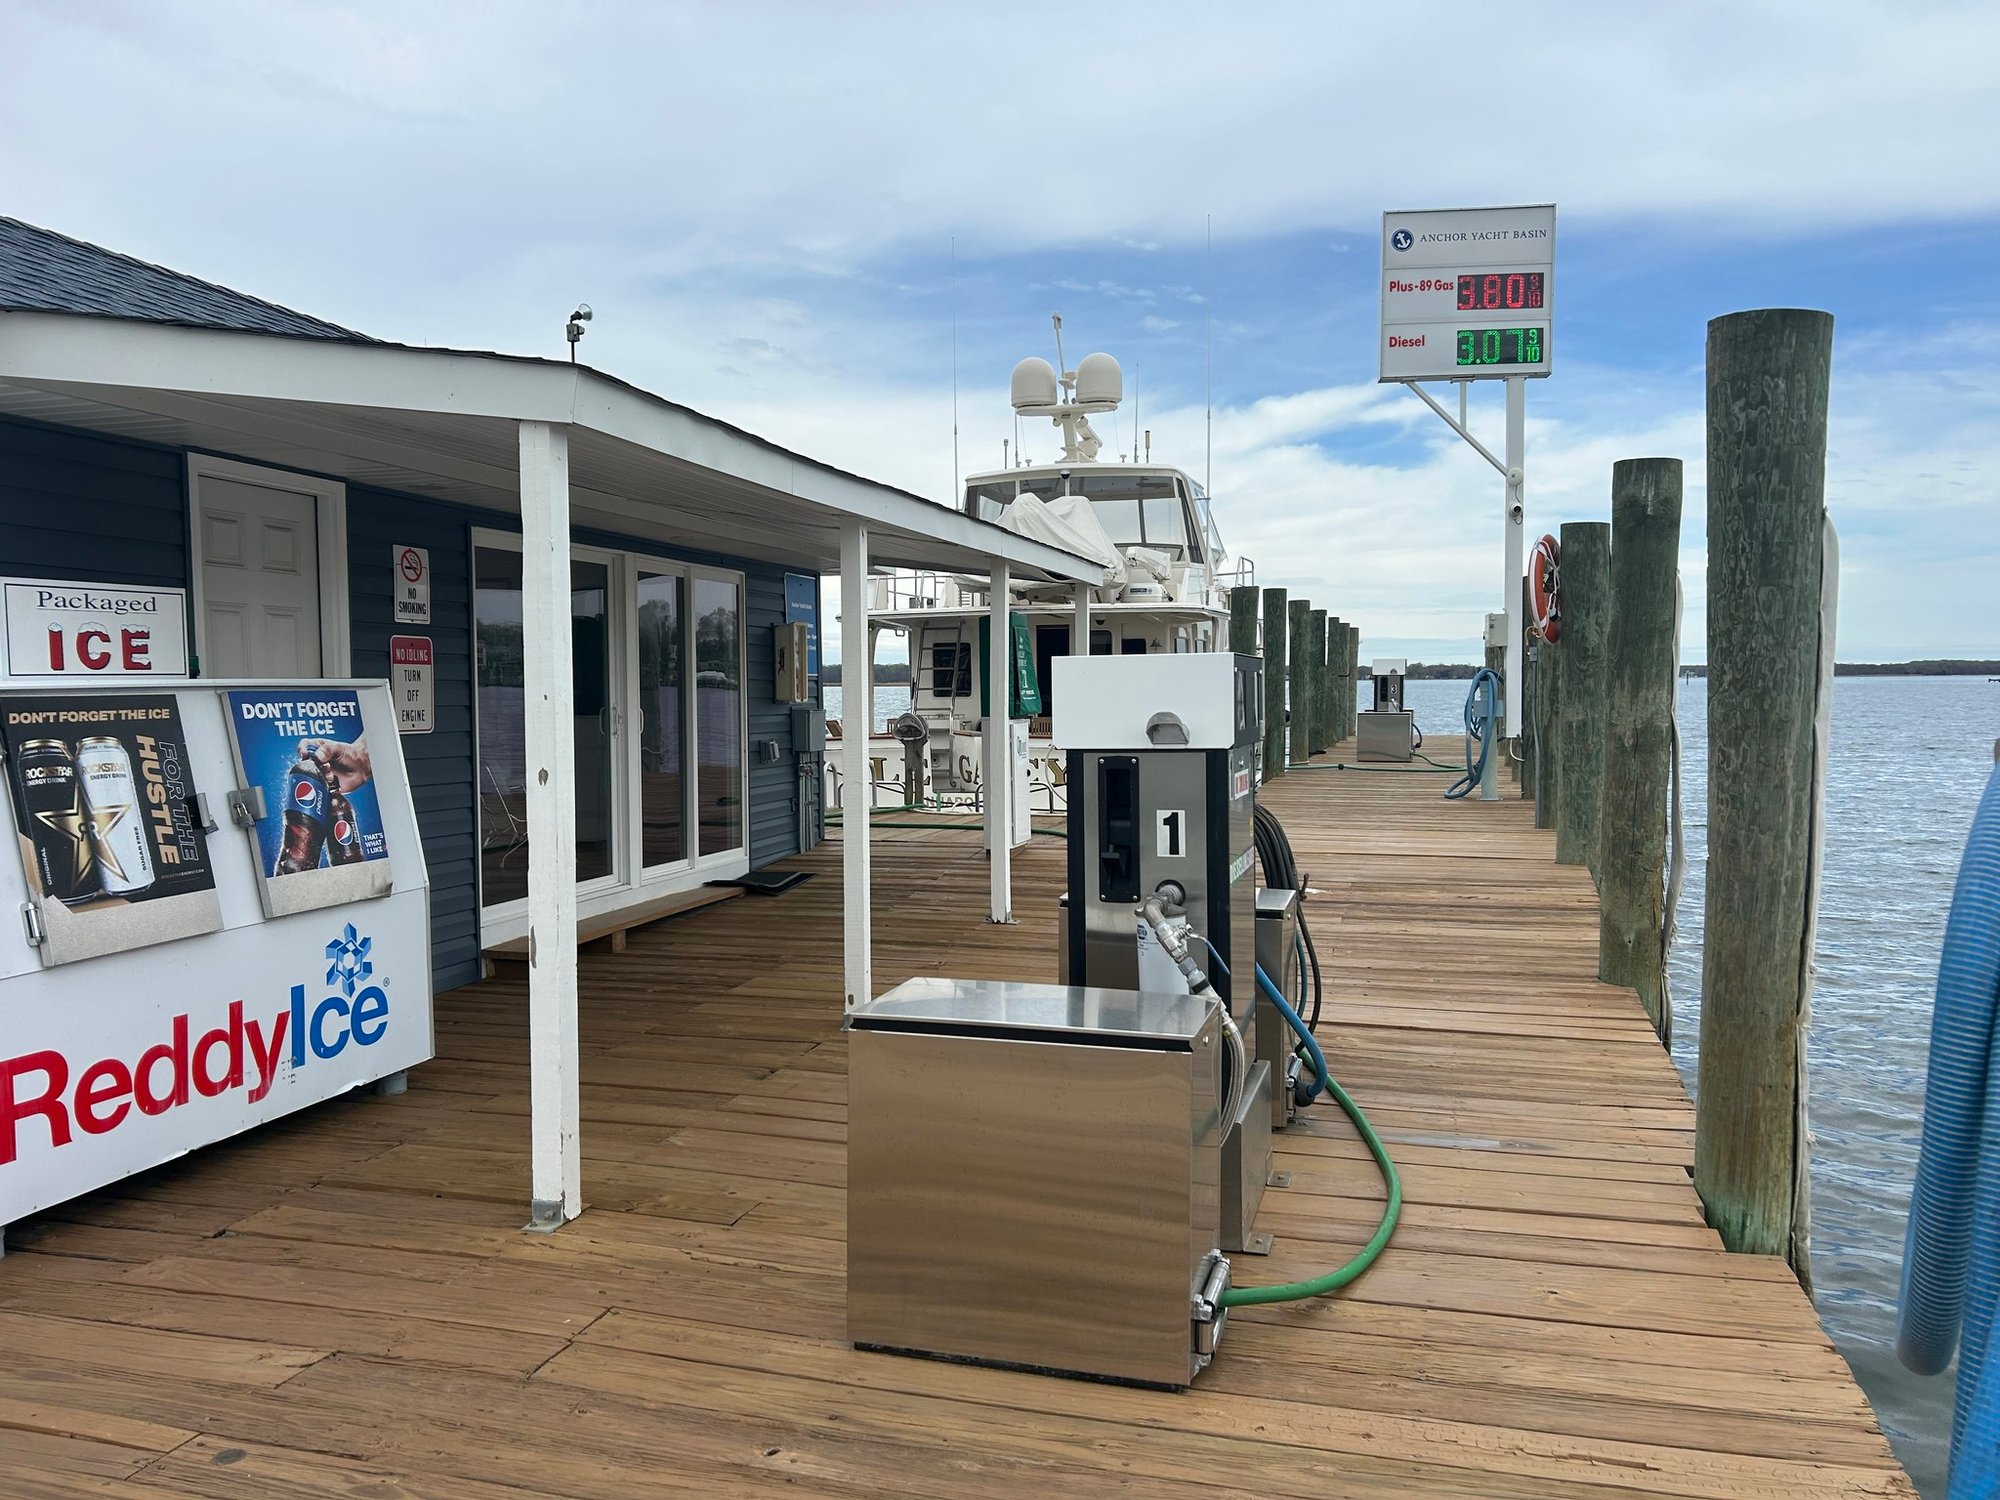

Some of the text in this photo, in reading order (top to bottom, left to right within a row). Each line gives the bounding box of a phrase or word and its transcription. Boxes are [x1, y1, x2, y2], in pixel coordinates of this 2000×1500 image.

[1420, 229, 1548, 243] ANCHOR YACHT BASIN
[1434, 279, 1454, 292] Gas
[1458, 274, 1525, 310] 3.80
[1389, 335, 1425, 348] Diesel
[1457, 329, 1524, 364] 3.07
[407, 587, 417, 600] NO
[36, 590, 158, 616] Packaged
[398, 601, 427, 615] SMOKING
[47, 621, 152, 671] ICE
[396, 648, 429, 662] NO IDLING
[404, 669, 421, 682] TURN
[407, 690, 420, 702] OFF
[8, 708, 170, 725] DON'T FORGET THE ICE
[241, 701, 356, 720] DON'T FORGET
[402, 709, 426, 723] ENGINE
[274, 719, 335, 737] THE ICE
[25, 765, 73, 779] ROCKSTAR
[82, 762, 126, 775] ROCKSTAR
[26, 778, 46, 787] ENERGY
[90, 773, 112, 781] ENERGY
[136, 734, 181, 865] HUSTLE
[159, 741, 199, 863] FOR THE
[363, 832, 384, 841] THAT'S
[1162, 811, 1180, 855] 1
[133, 826, 147, 871] SUGAR FREE
[366, 839, 382, 847] WHAT
[370, 846, 384, 854] LIKE
[41, 847, 53, 886] ORIGINAL
